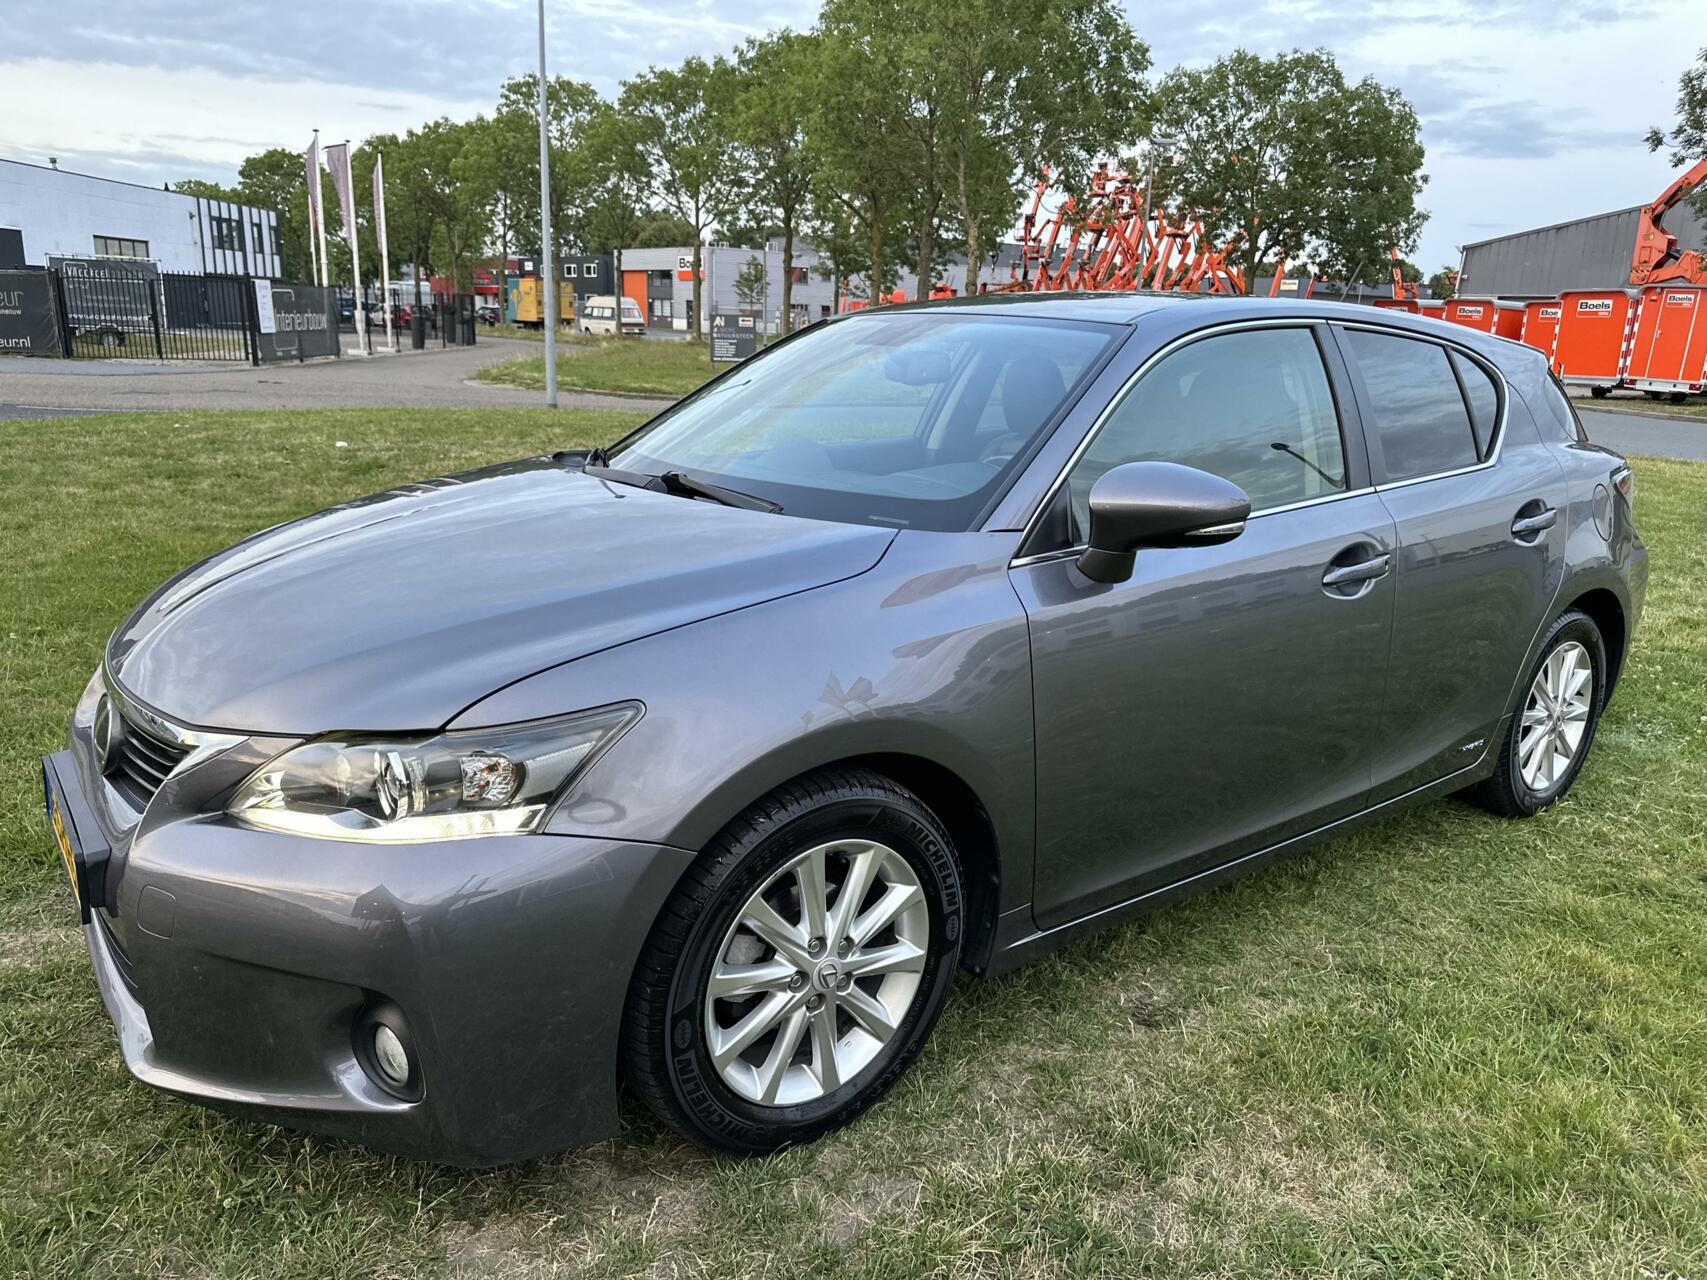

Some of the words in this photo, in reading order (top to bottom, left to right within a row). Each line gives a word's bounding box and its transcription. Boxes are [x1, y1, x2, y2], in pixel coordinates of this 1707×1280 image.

[1459, 307, 1482, 315] Boels
[1579, 301, 1611, 310] Boels
[904, 820, 959, 908] MICHELIN
[676, 1057, 750, 1139] MICHELIN
